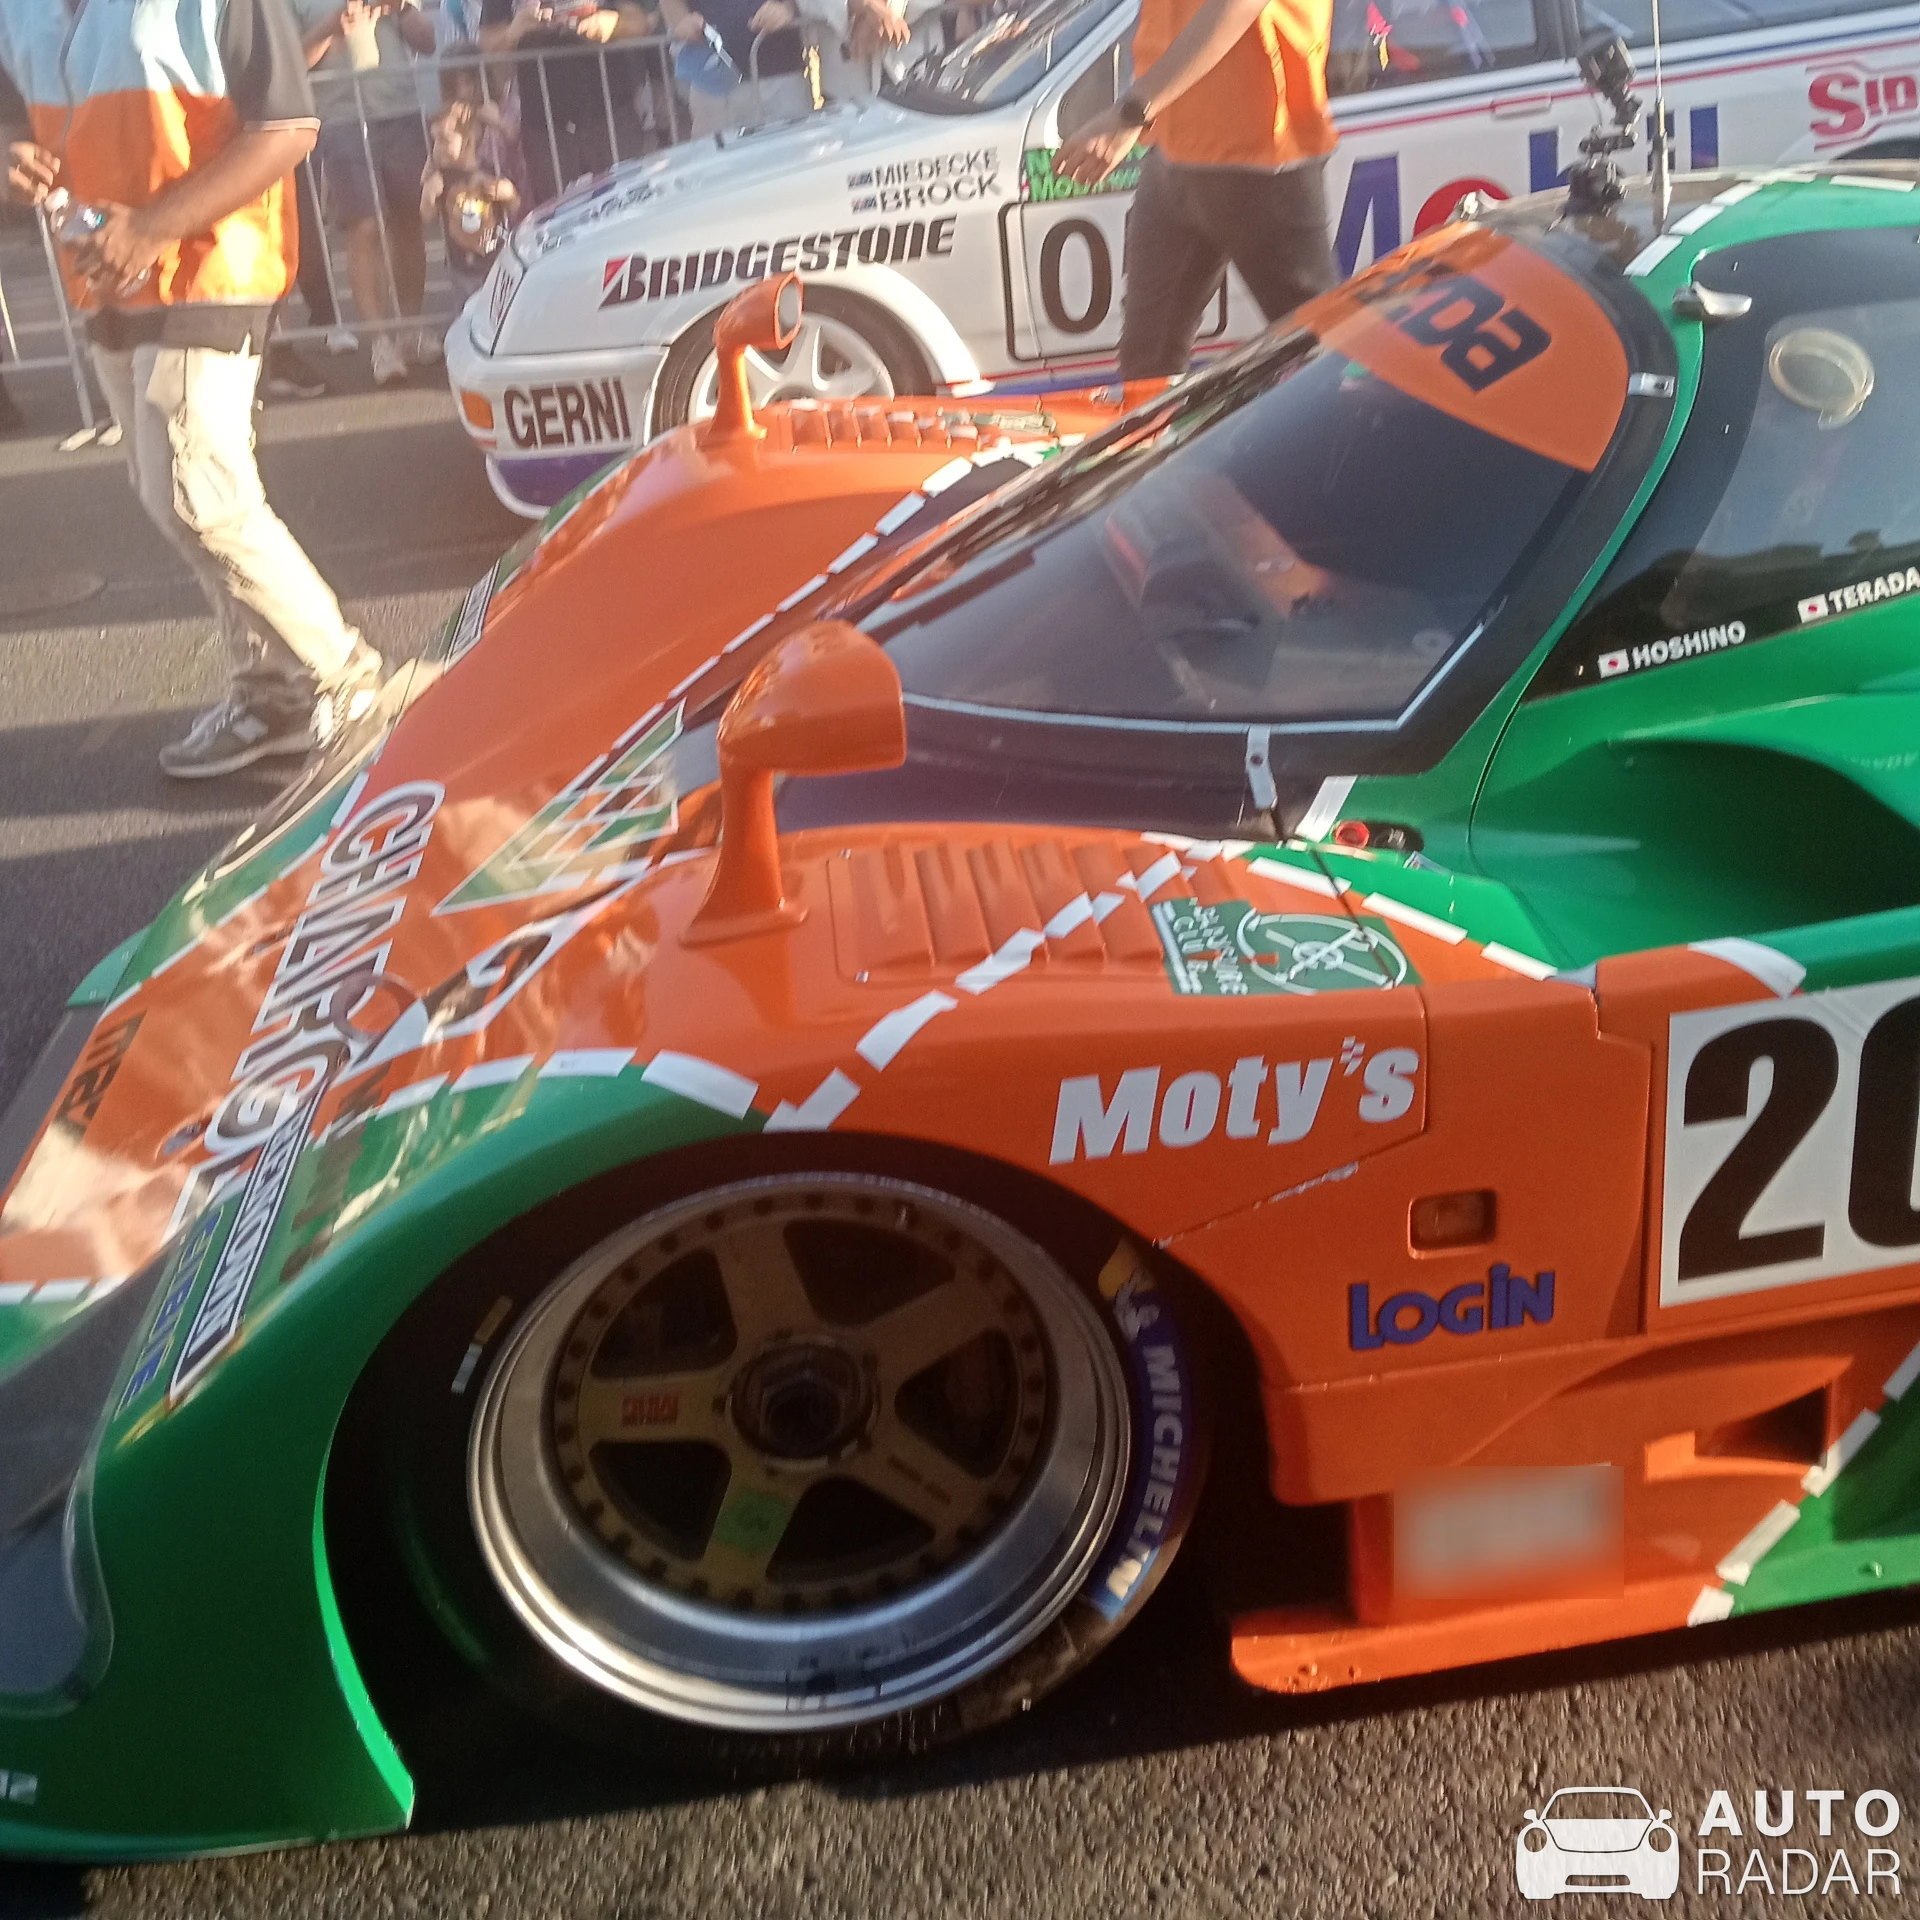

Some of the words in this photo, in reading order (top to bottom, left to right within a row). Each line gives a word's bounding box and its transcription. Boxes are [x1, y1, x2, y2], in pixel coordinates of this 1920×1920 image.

[874, 147, 1000, 188] MIEDECKE
[879, 174, 1001, 212] BROCK
[598, 214, 958, 309] BRIDGESTONE
[503, 377, 631, 448] GERNI
[1829, 566, 1920, 613] TERADA
[1632, 620, 1746, 669] HOSHINO
[1049, 1036, 1420, 1165] Moty's
[1108, 1343, 1185, 1602] MICHELIN
